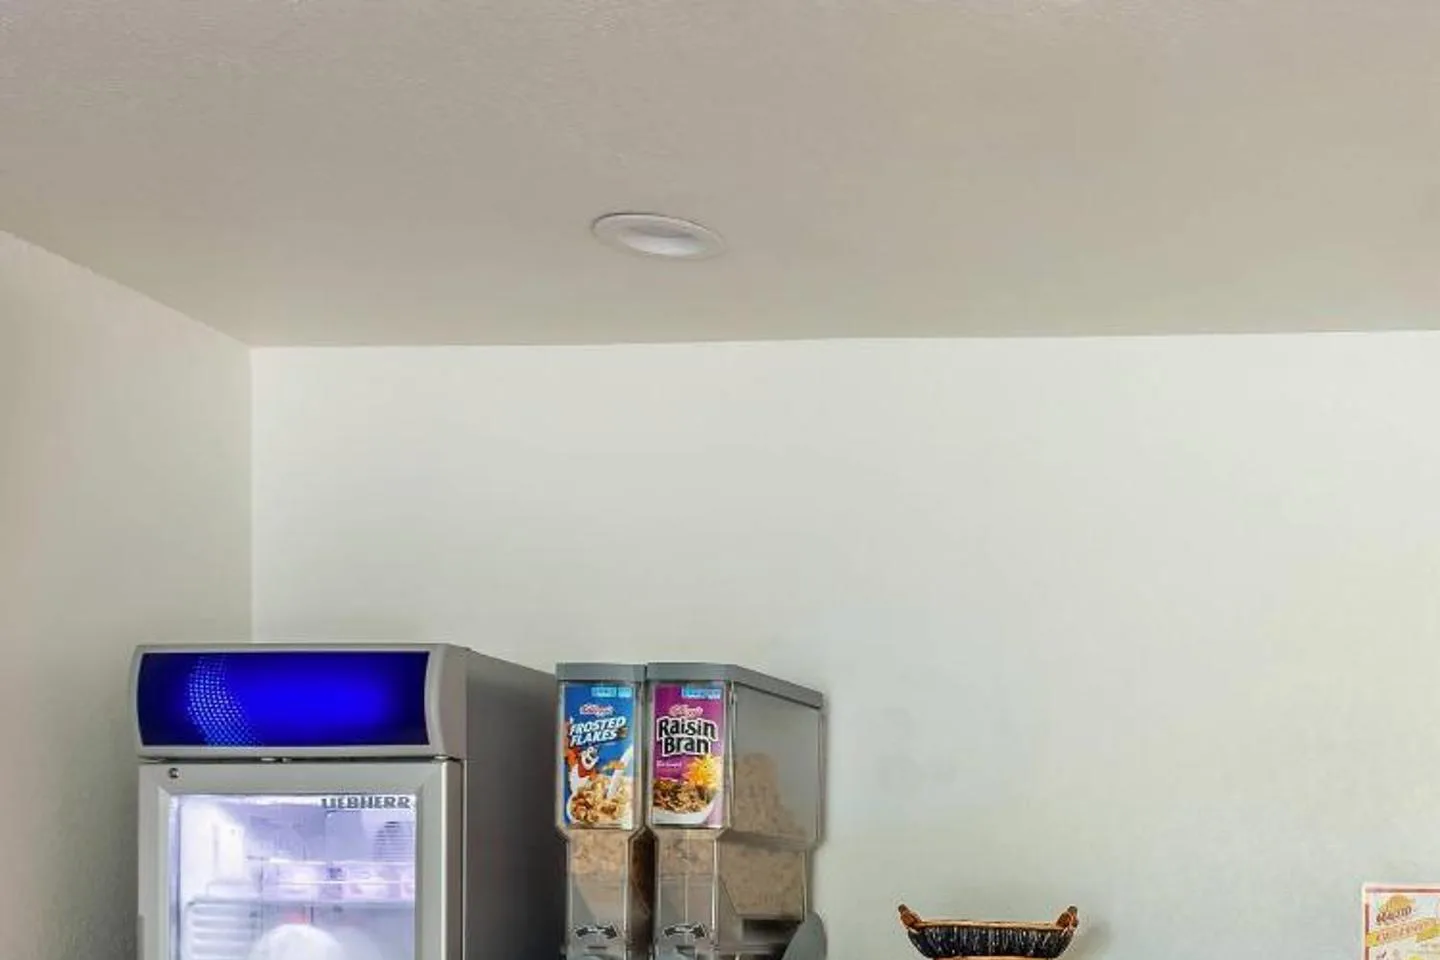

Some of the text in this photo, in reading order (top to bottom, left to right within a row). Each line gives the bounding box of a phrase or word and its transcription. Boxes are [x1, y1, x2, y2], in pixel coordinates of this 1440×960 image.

[570, 716, 626, 737] FROSTED
[657, 717, 717, 740] Raisin
[571, 729, 618, 746] FLAKES
[663, 736, 710, 755] Bran
[321, 796, 410, 809] LIEBHERR
